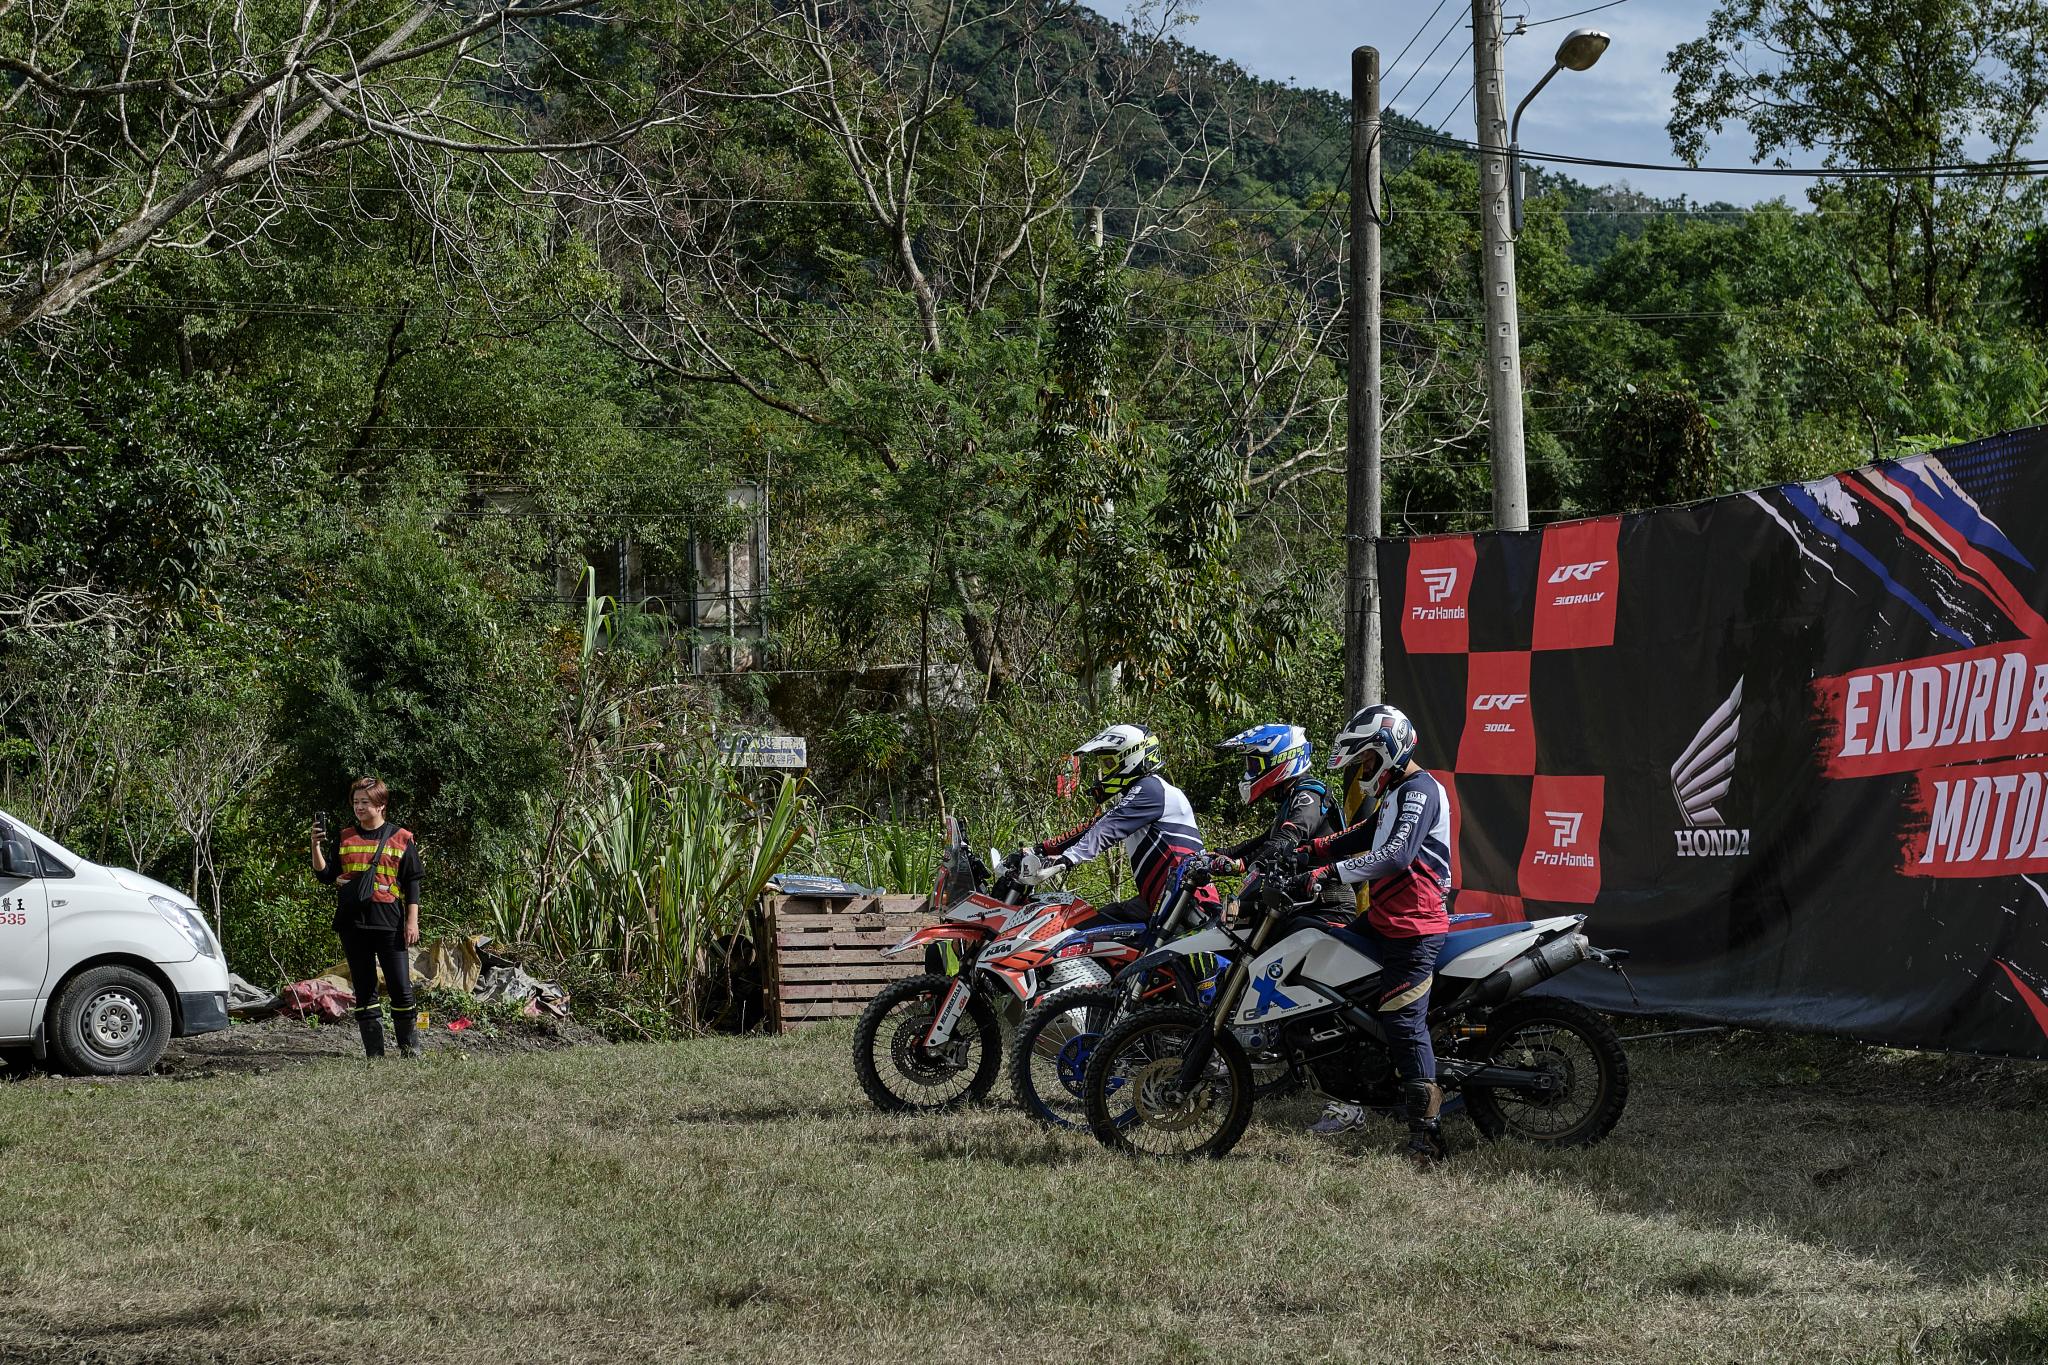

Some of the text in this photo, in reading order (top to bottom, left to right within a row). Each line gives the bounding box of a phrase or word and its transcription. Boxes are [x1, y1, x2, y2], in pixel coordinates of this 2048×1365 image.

[1548, 560, 1609, 583] CRF
[1472, 694, 1528, 710] CRF
[1837, 652, 2028, 758] ENDURO
[1483, 723, 1516, 732] 300L
[1270, 745, 1306, 767] 100%
[1674, 829, 1750, 857] HONDA
[984, 943, 1012, 958] KTM
